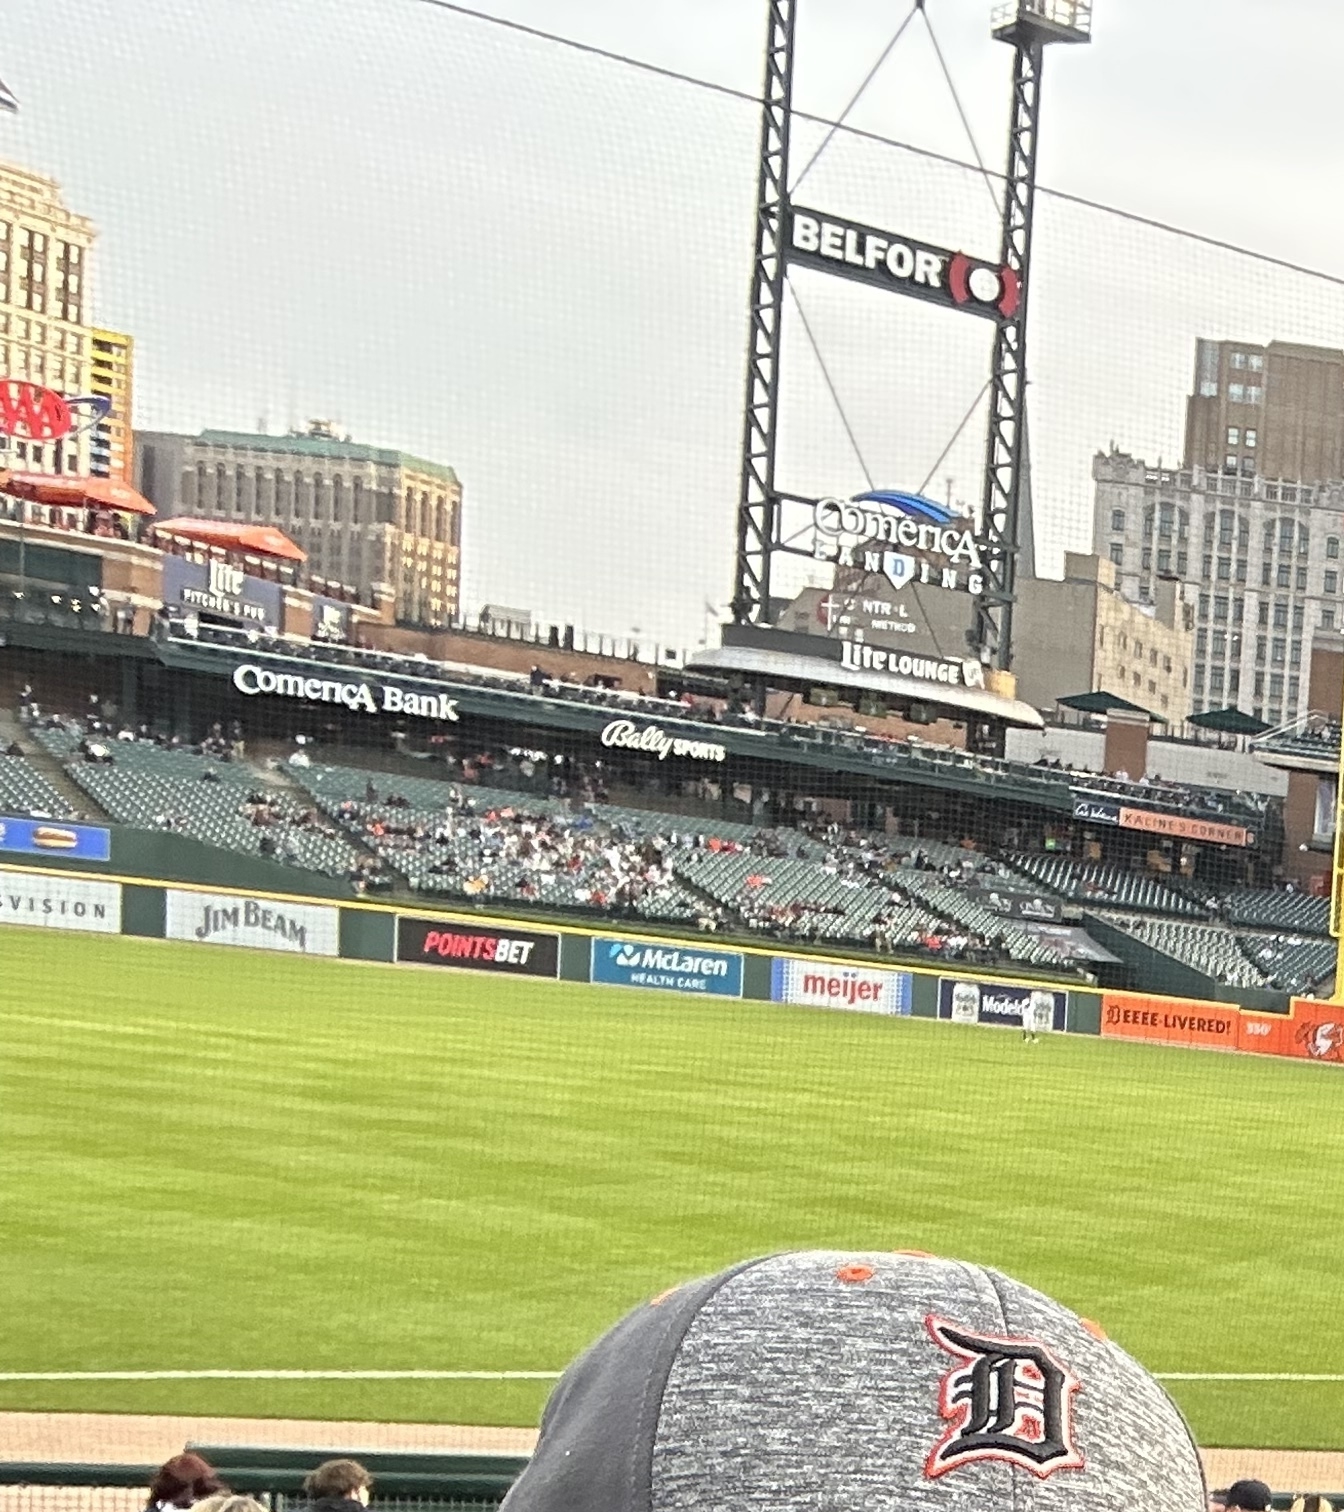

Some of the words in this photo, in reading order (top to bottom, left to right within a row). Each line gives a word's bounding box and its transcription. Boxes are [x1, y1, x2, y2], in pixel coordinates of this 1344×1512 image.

[792, 212, 943, 288] BELFOR
[208, 558, 244, 597] Lite
[841, 640, 887, 671] Lite
[888, 653, 960, 685] LOUNGE
[381, 685, 460, 722] Bank
[601, 719, 673, 761] Bally
[673, 738, 727, 762] SPORTS
[195, 905, 240, 939] JIM
[243, 900, 307, 948] BEAM
[423, 930, 535, 966] POINTSBET
[642, 948, 729, 978] McLaren
[630, 972, 672, 986] HEALTH
[677, 977, 707, 990] CARE
[803, 970, 883, 1004] meijer
